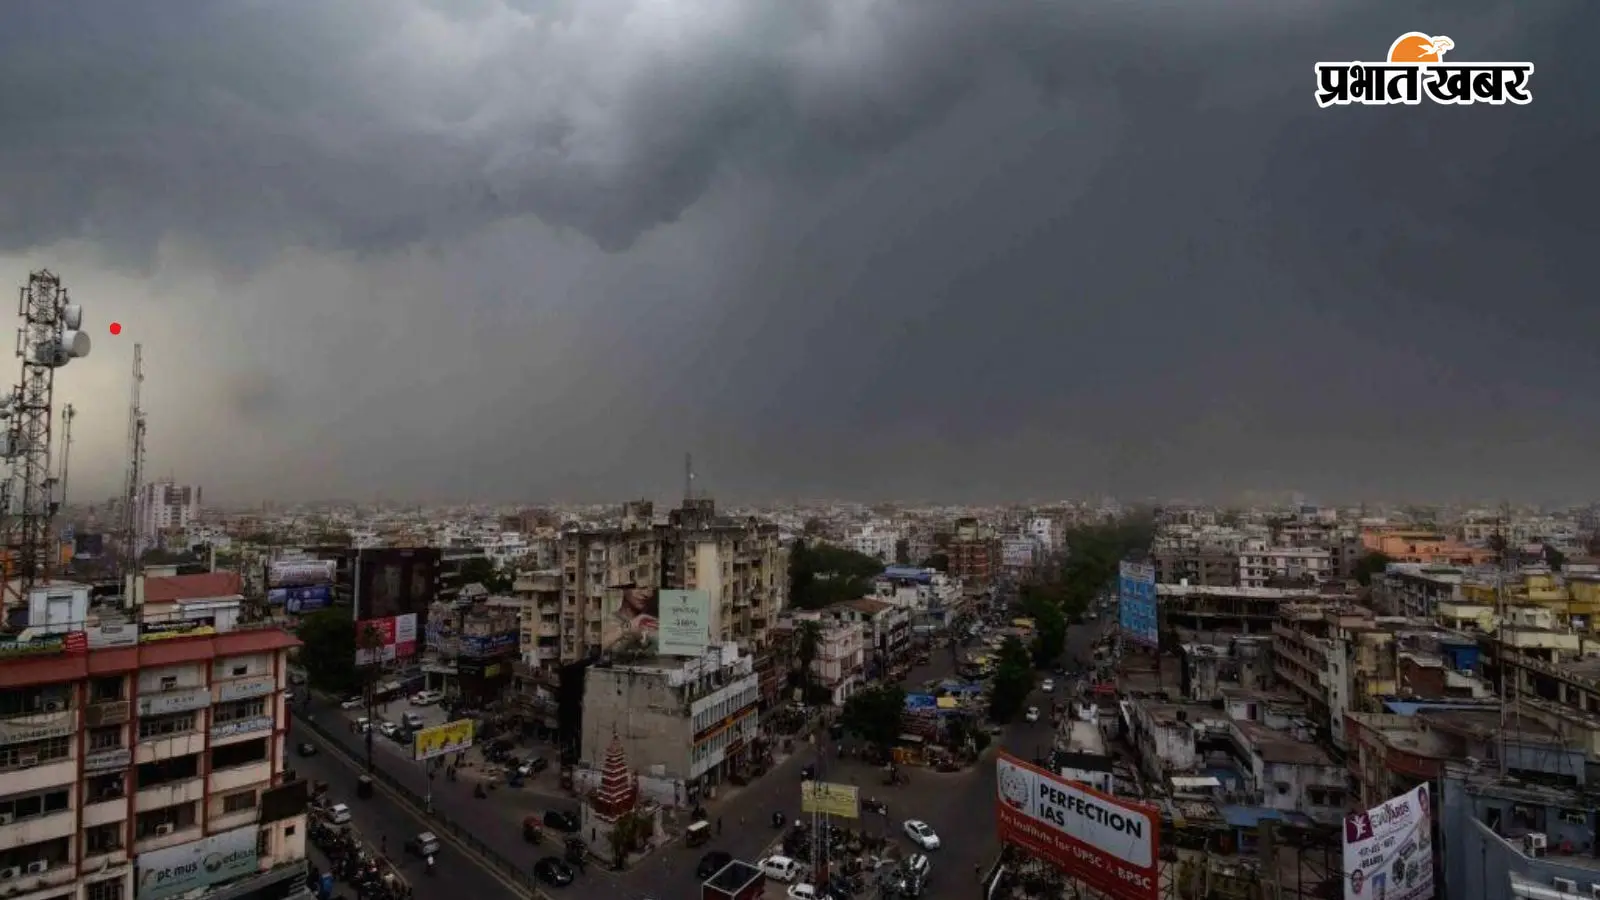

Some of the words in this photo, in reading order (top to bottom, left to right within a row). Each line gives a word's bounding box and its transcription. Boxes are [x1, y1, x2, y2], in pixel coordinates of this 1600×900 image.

[1040, 784, 1142, 838] PERFECTION
[1040, 803, 1065, 827] IAS
[1073, 846, 1103, 867] UPSC
